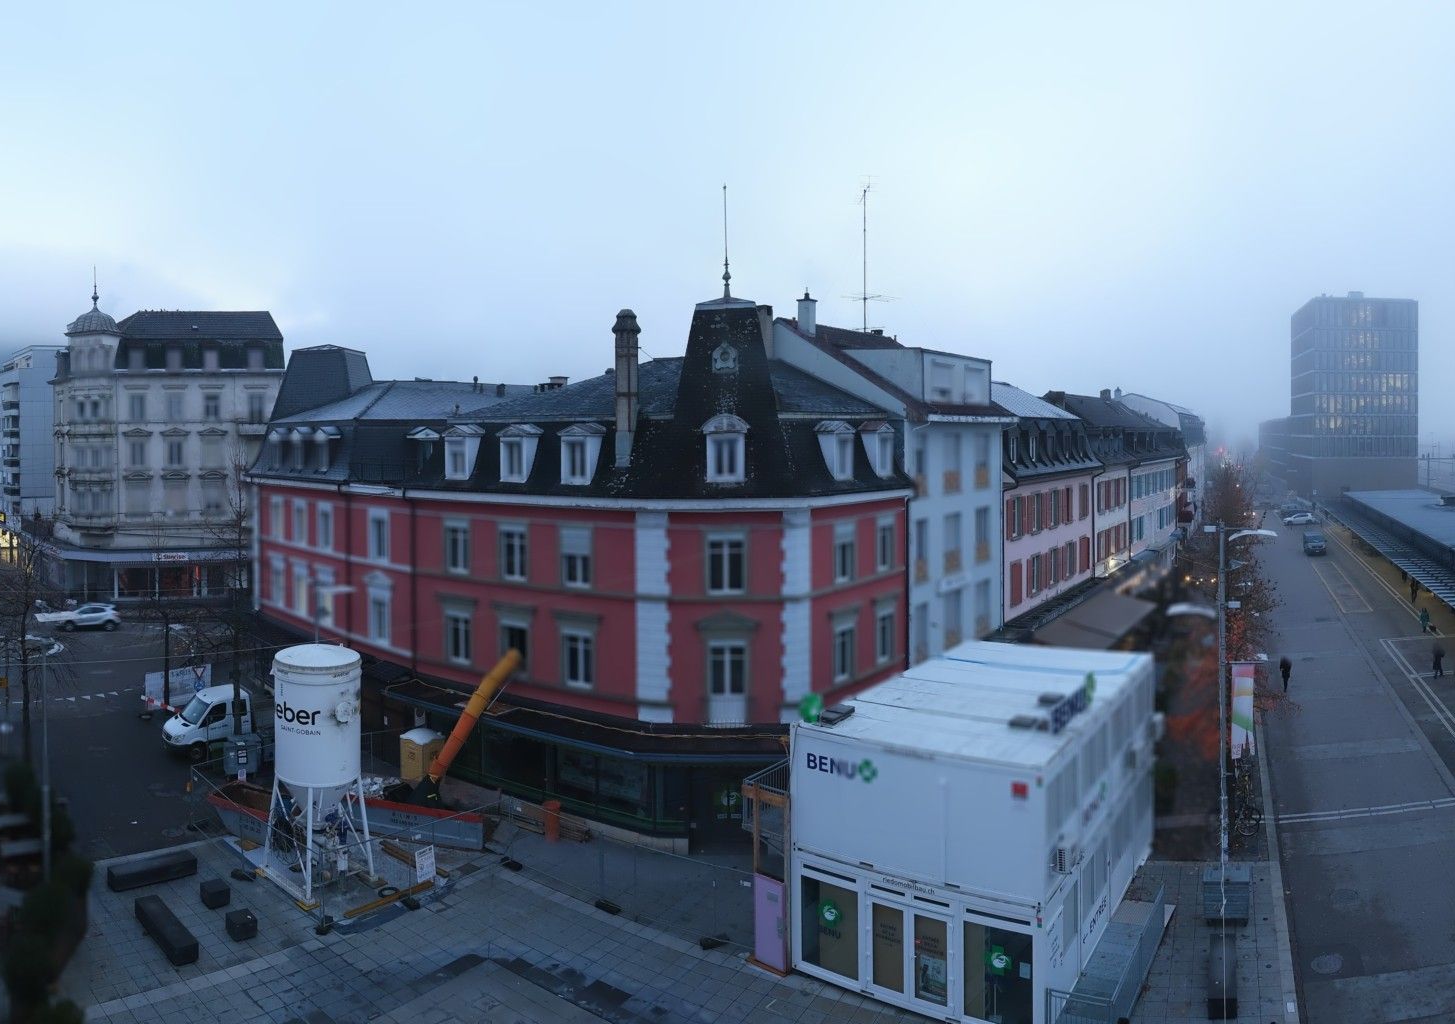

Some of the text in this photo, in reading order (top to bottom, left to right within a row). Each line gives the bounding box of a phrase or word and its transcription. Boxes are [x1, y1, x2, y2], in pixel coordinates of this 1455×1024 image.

[280, 724, 321, 736] SAINT-GOBAIN
[806, 752, 857, 780] BENU
[882, 877, 936, 895] riedomobilbau.ch
